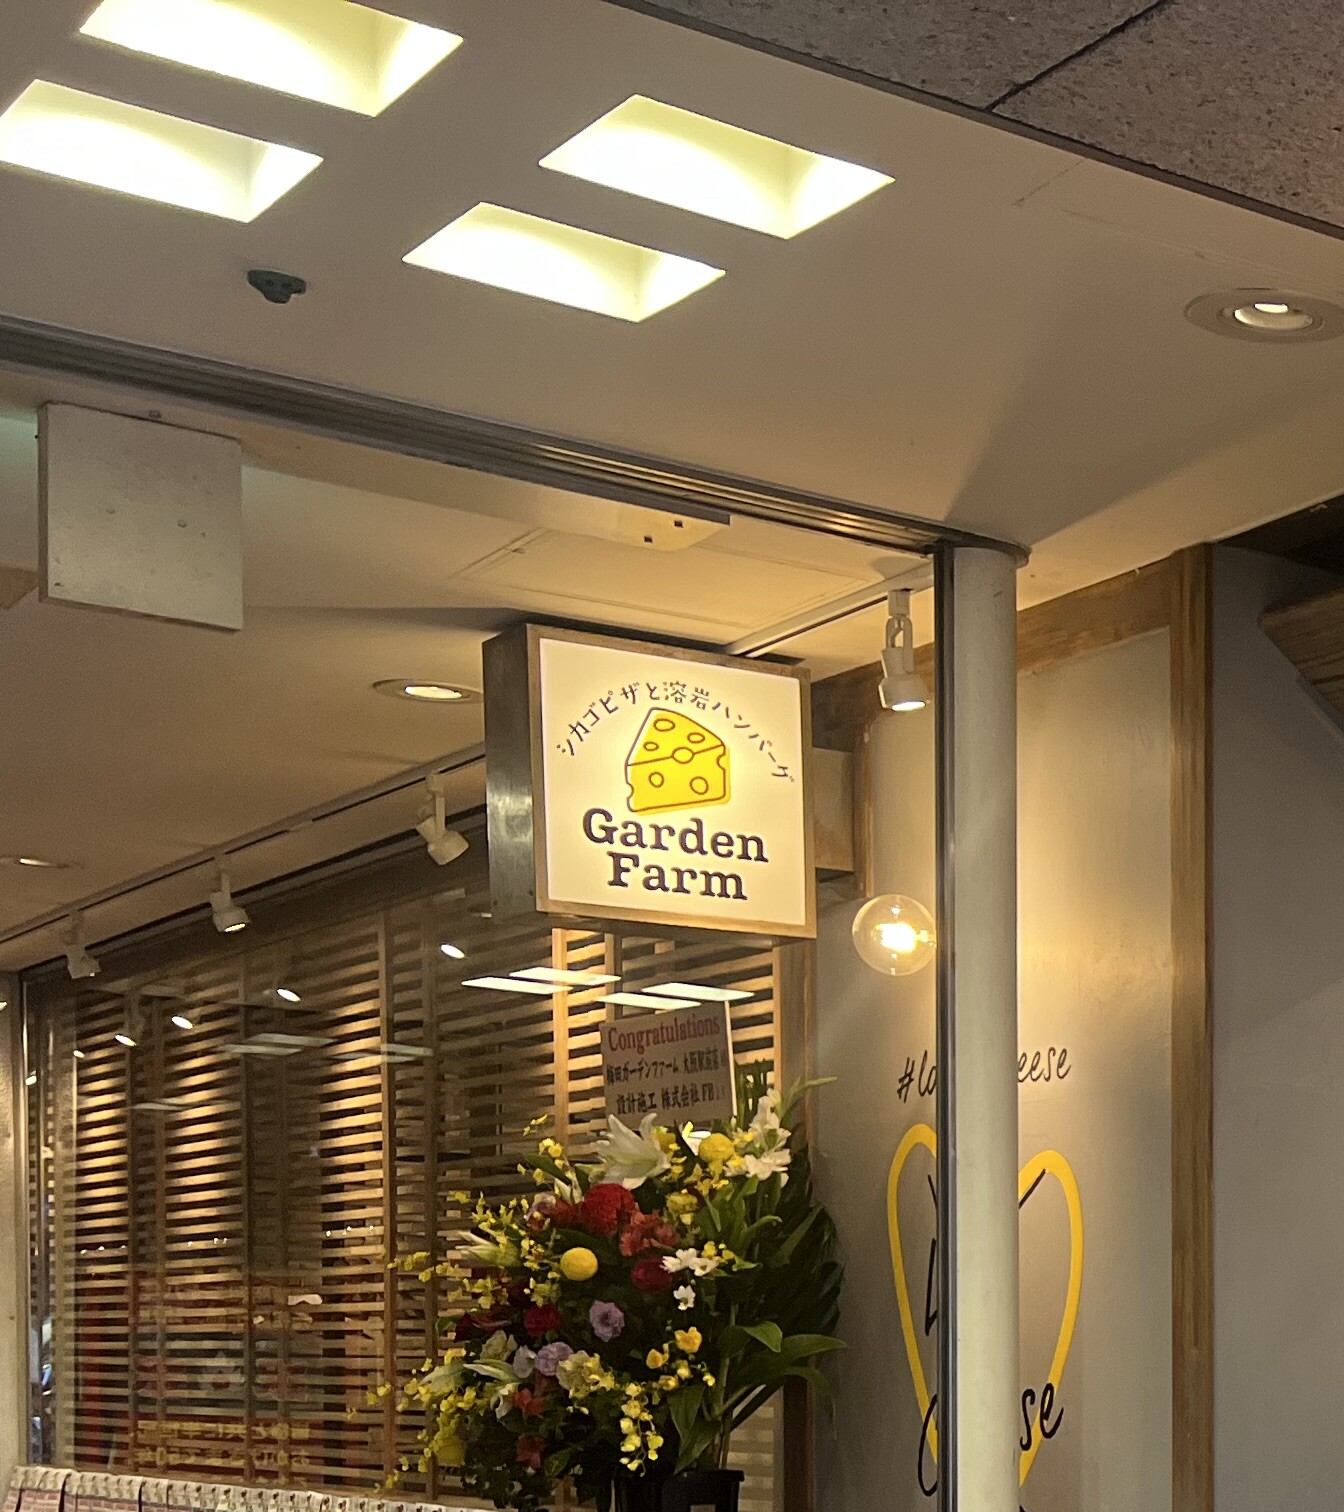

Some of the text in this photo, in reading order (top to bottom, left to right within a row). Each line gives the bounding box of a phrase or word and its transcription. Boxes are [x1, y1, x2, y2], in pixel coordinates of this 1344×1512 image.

[557, 681, 794, 782] シカゴピザと溶岩ハンバーグ
[583, 808, 769, 863] Garden
[607, 851, 748, 900] Farm
[608, 1013, 720, 1054] Congratulations
